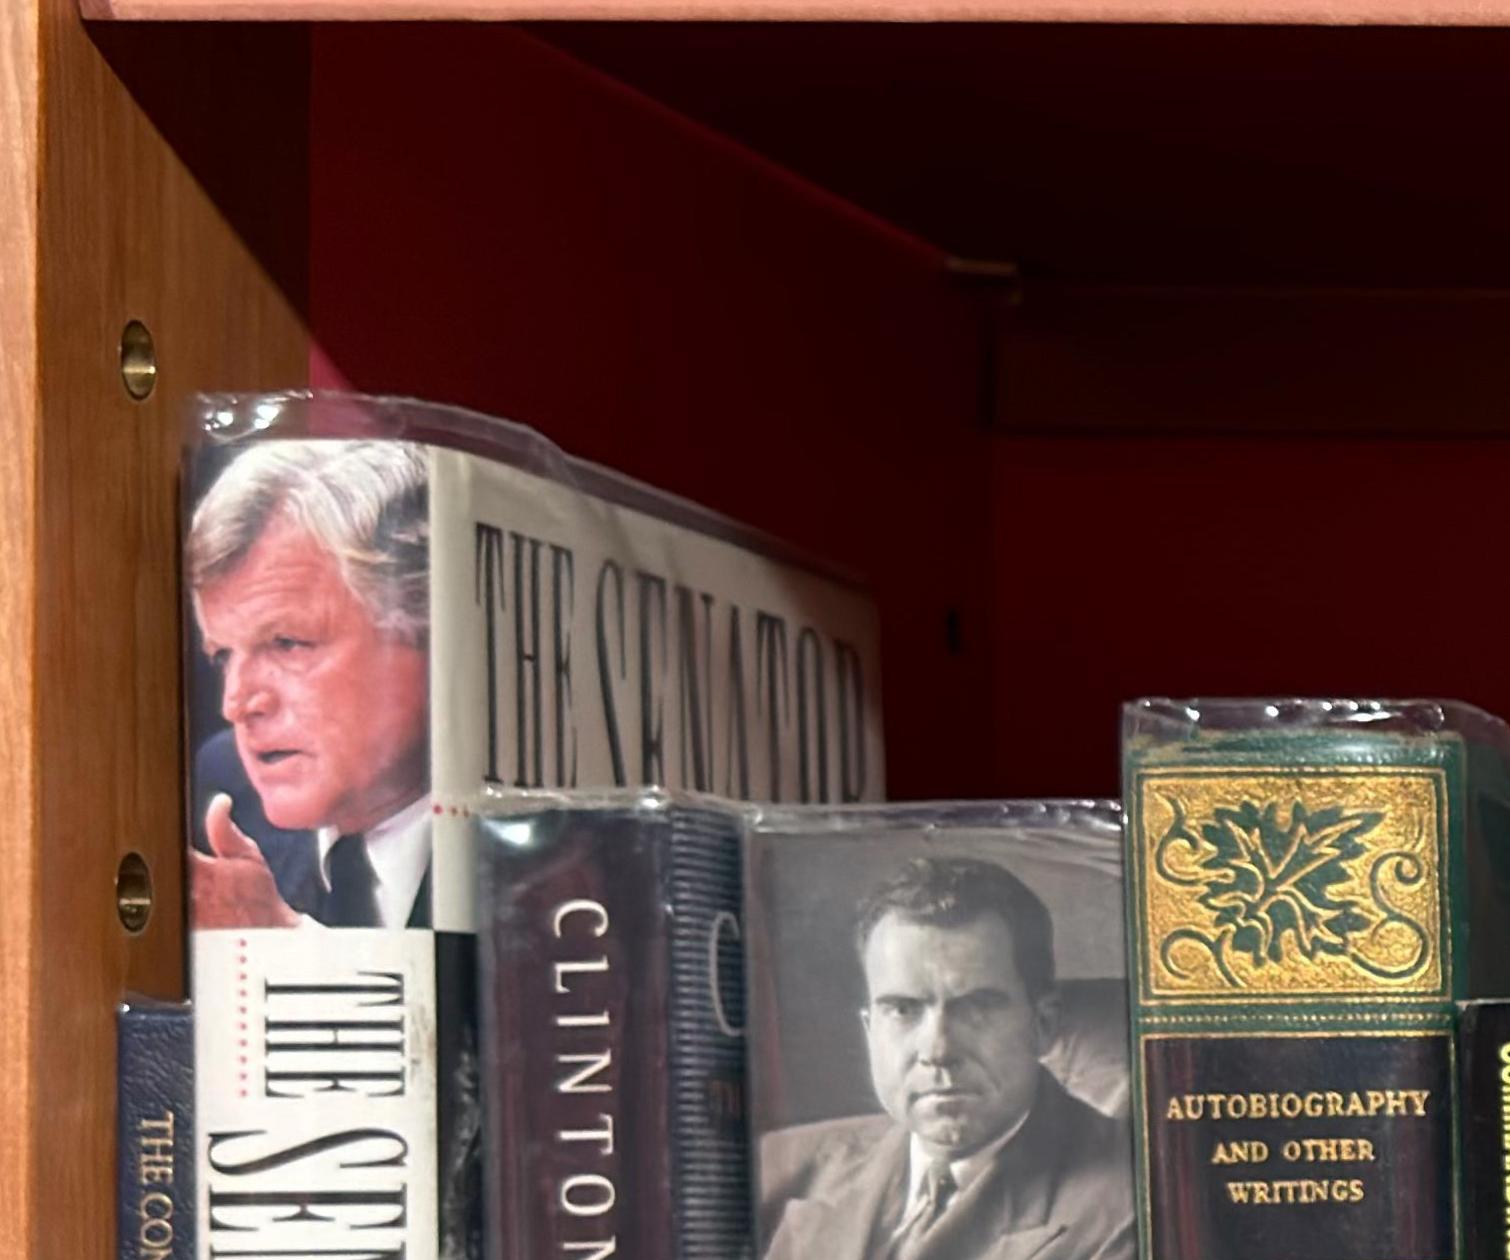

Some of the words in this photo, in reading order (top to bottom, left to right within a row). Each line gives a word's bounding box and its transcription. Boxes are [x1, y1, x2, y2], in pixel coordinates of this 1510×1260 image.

[264, 972, 406, 1099] THE
[1166, 1089, 1431, 1121] AUTOBIOGRAPHY
[141, 1110, 174, 1184] THE
[1211, 1140, 1269, 1164] AND
[1282, 1138, 1376, 1163] OTHER
[1226, 1179, 1366, 1205] WRITINGS
